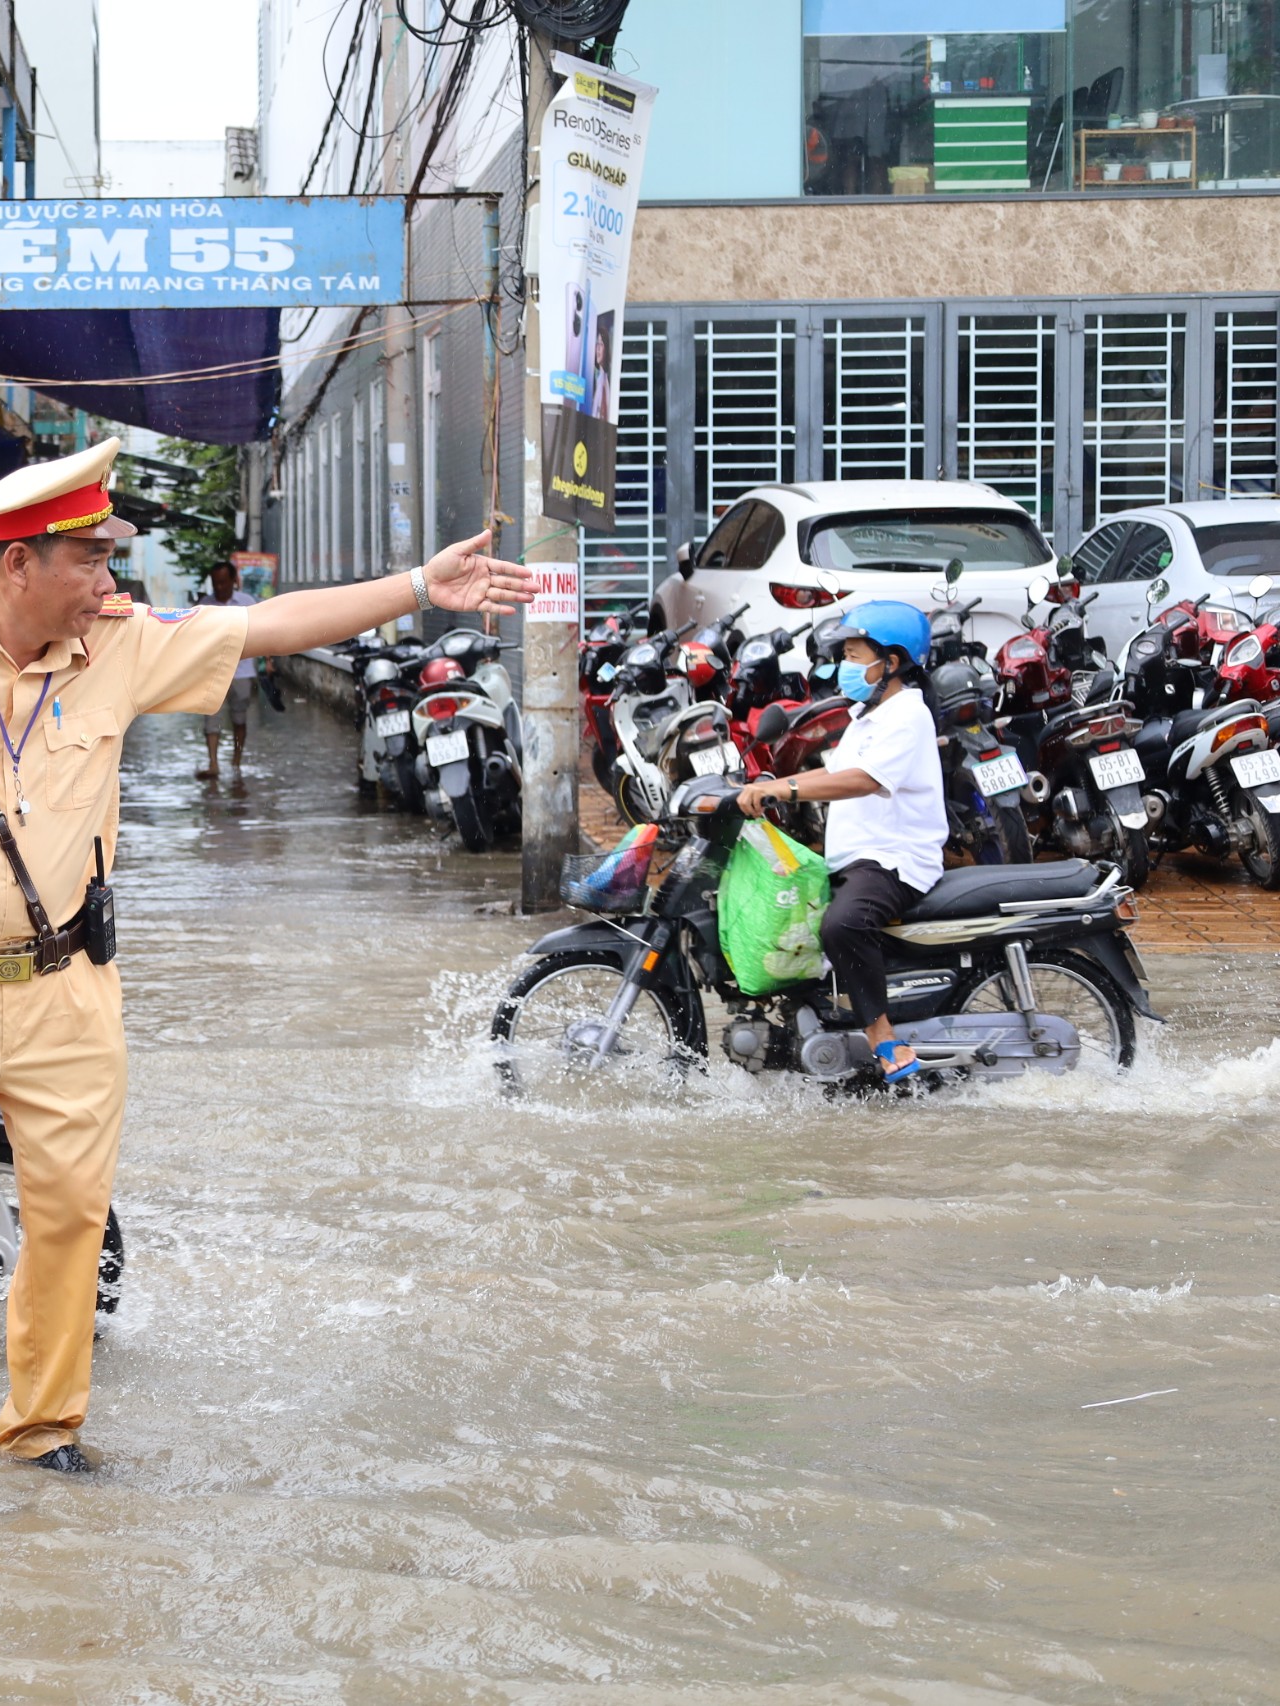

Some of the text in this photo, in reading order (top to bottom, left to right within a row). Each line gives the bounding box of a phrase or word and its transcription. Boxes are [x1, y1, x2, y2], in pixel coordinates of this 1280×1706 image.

[27, 203, 79, 223] VỰC
[83, 205, 97, 219] 2
[102, 204, 122, 219] P.
[128, 203, 161, 218] AN
[170, 199, 224, 218] HÒA
[170, 227, 295, 273] 55
[33, 273, 114, 291] CÁCH
[120, 276, 205, 293] MẠNG
[212, 273, 313, 291] THÁNG
[319, 273, 380, 290] TÁM
[980, 757, 1014, 779] 65-E1
[1098, 752, 1131, 772] 65-B1
[1239, 753, 1274, 771] 65-X3
[981, 770, 1025, 794] 588.61
[1098, 766, 1142, 788] 701.59
[1243, 766, 1279, 785] 7498
[902, 976, 943, 988] HONDA
